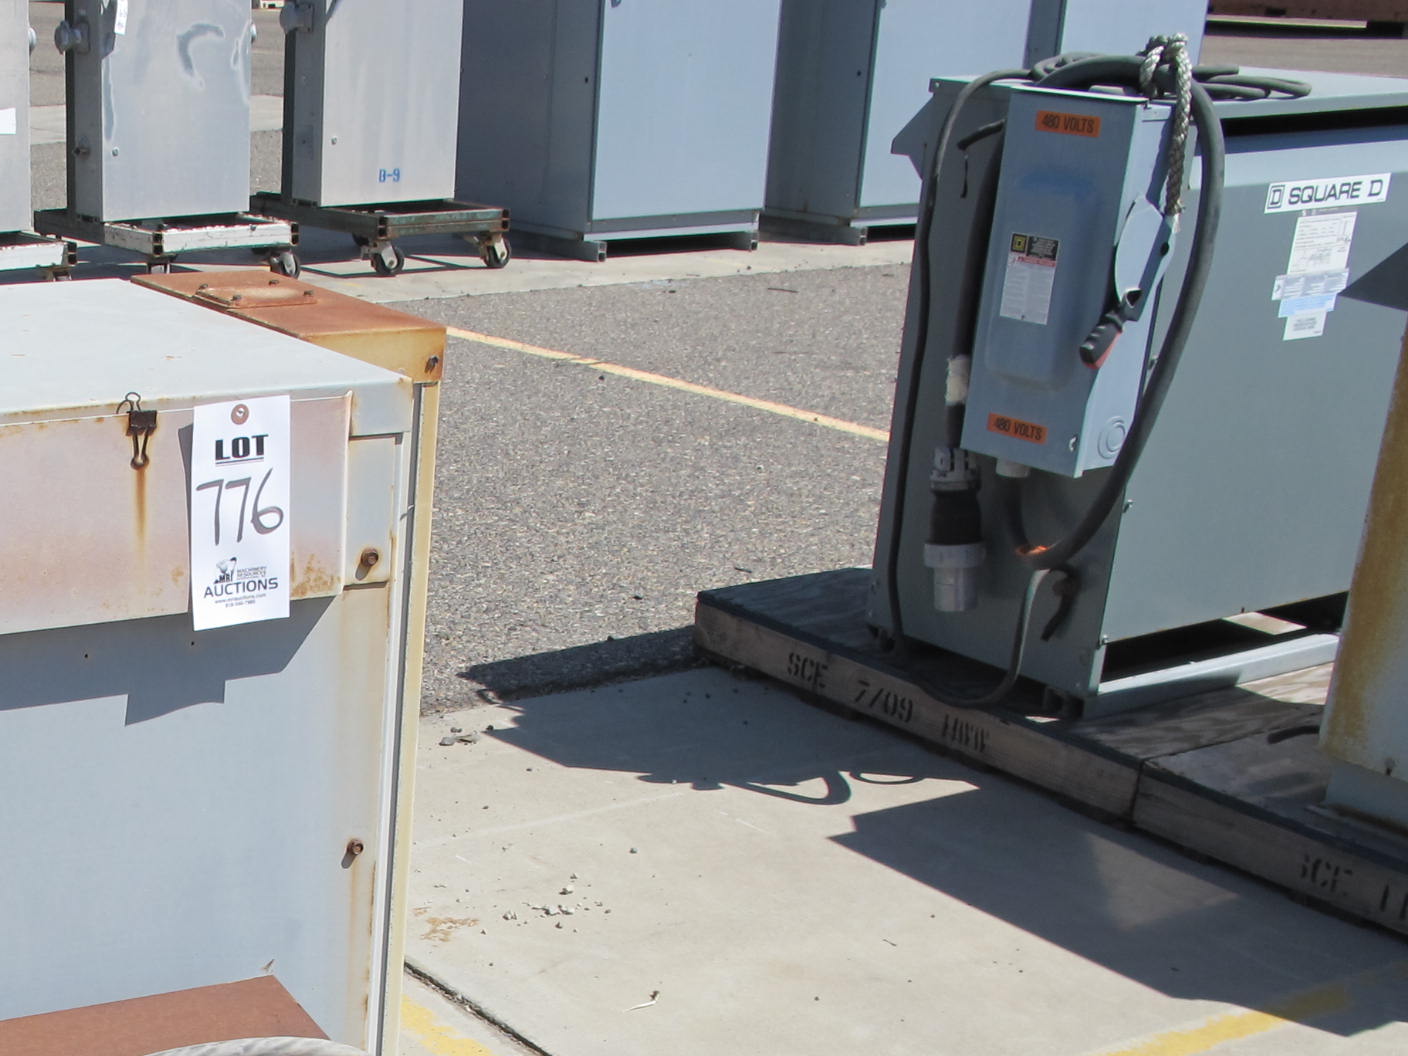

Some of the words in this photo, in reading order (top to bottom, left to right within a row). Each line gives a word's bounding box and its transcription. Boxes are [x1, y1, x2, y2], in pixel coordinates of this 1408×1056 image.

[1064, 117, 1095, 133] VOLTS
[379, 168, 401, 182] B-9
[1288, 181, 1363, 205] SQUARE
[1368, 179, 1384, 196] D
[1014, 422, 1043, 441] VOLTS
[215, 433, 269, 461] LOT
[195, 467, 284, 546] 776
[203, 577, 279, 599] AUCTIONS
[787, 652, 828, 690] SCE
